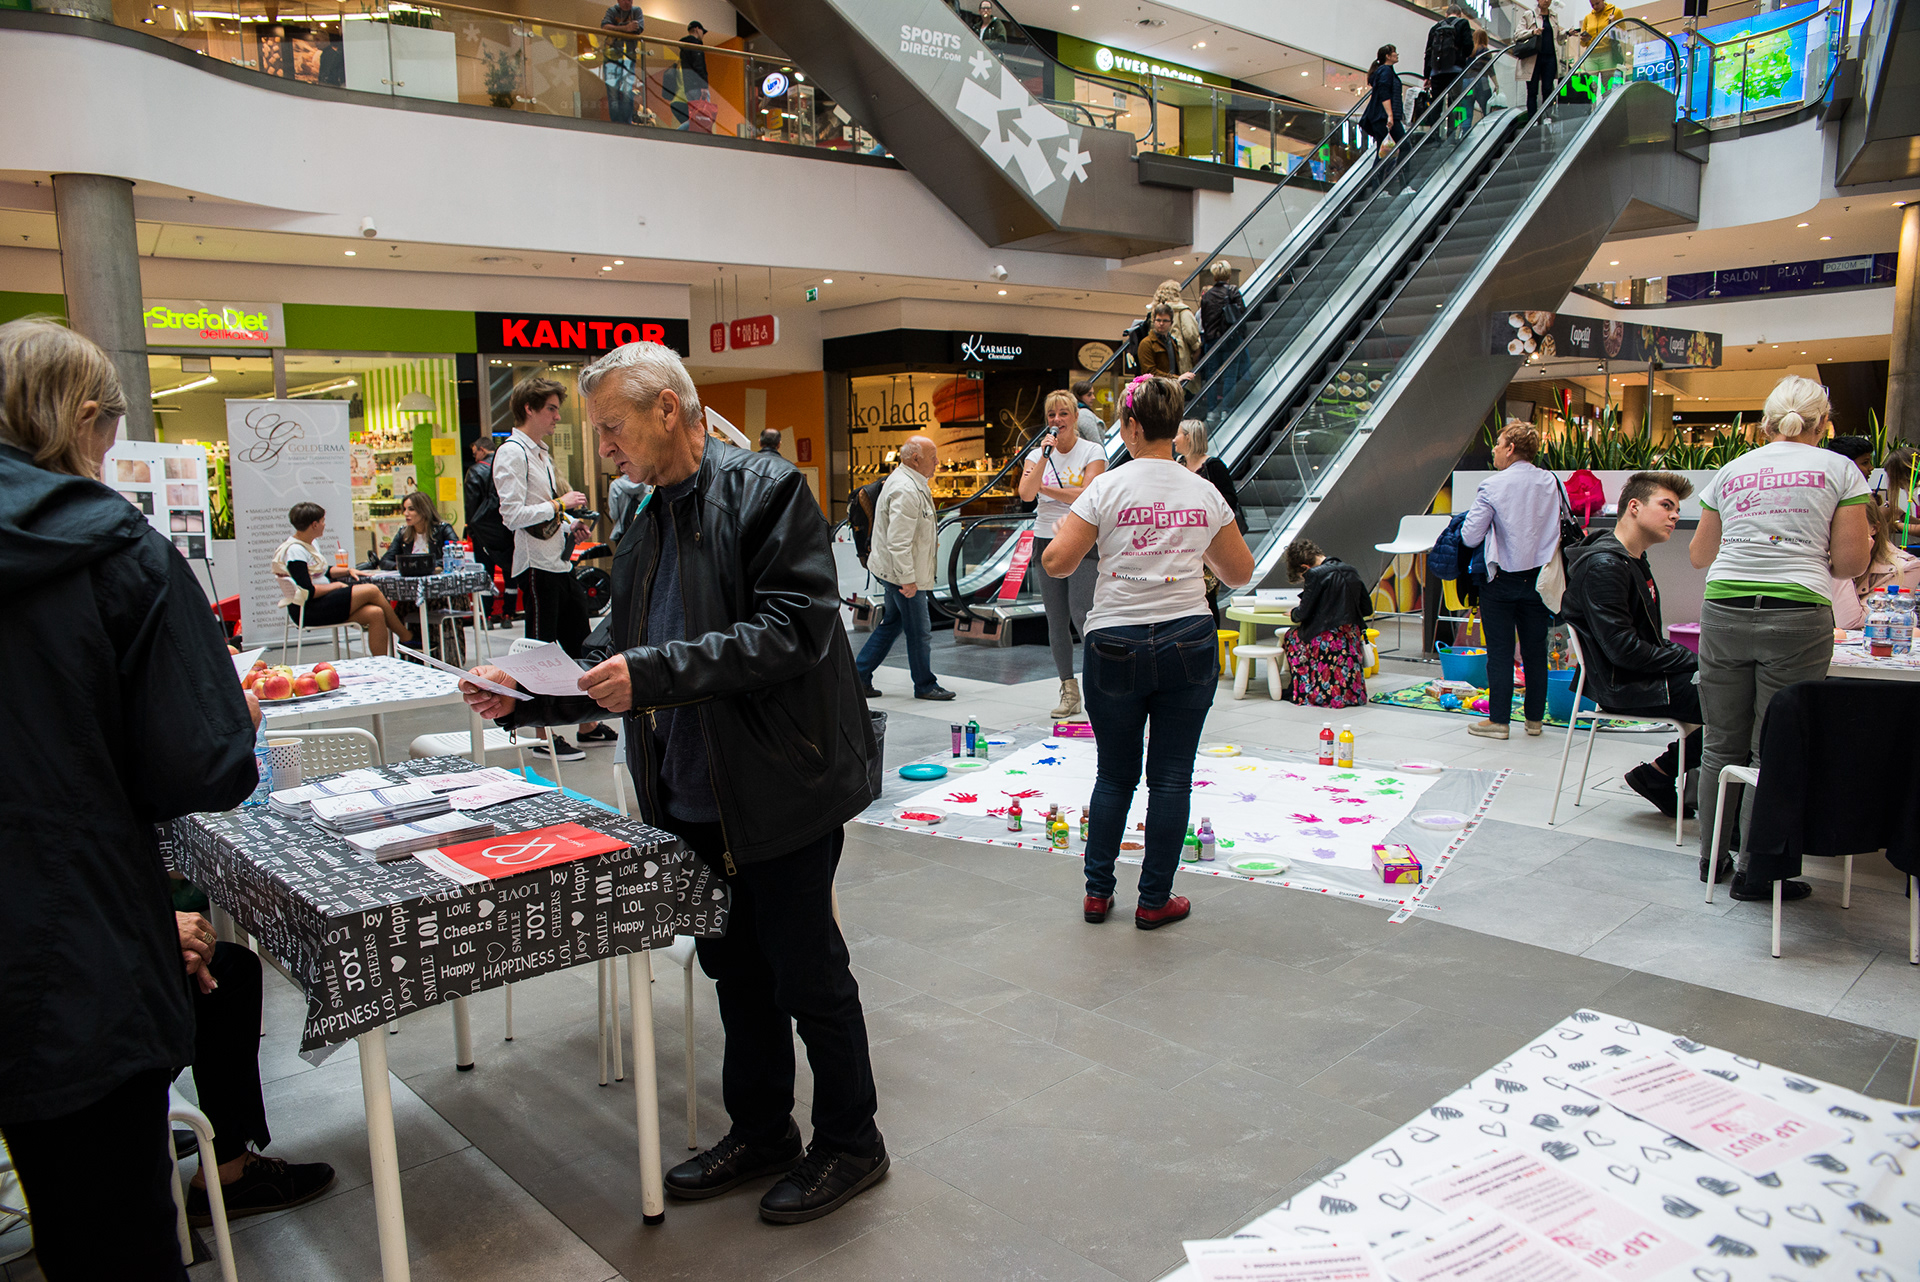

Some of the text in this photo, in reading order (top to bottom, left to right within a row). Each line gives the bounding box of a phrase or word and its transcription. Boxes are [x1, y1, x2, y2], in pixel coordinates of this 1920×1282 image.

[900, 24, 961, 50] SPORTS
[899, 40, 961, 63] DIRECT.COM
[1115, 55, 1148, 74] YVES
[1637, 56, 1689, 77] POGOD
[1722, 264, 1807, 284] SALON PLAY
[1826, 261, 1857, 272] POZIOM
[502, 318, 665, 349] KANTOR
[980, 345, 1022, 355] KARMELLO
[852, 387, 931, 427] kolada
[288, 443, 345, 453] GOLDERMA
[1763, 472, 1823, 489] BIUST
[1158, 511, 1206, 527] BIUST
[660, 850, 696, 866] LOVE
[550, 869, 568, 886] Joy
[619, 863, 638, 877] LOVE
[498, 883, 540, 903] LOVE
[615, 880, 659, 898] Cheers
[662, 872, 674, 893] FUN
[691, 864, 711, 906] CHEERS
[447, 902, 471, 917] LOVE
[551, 890, 562, 938] CHEERS
[622, 900, 645, 914] LOL
[362, 912, 383, 929] Joy
[443, 920, 492, 940] Cheers
[497, 909, 507, 932] FUN
[526, 902, 546, 940] JOY
[613, 920, 645, 935] Happy
[694, 910, 708, 936] LOL
[709, 904, 728, 934] Joy
[511, 911, 522, 953] SMILE
[596, 911, 609, 955] SMILE
[452, 941, 477, 957] LOL
[559, 939, 572, 967] LOL
[574, 929, 591, 961] Joy
[339, 947, 365, 992] JOY
[364, 933, 382, 988] CHEERS
[441, 961, 475, 979] Happy
[483, 949, 555, 981] HAPPINESS
[323, 959, 344, 1009] SMILE
[420, 954, 438, 1002] SMILE
[381, 988, 397, 1020] LOL
[399, 976, 418, 1011] Joy
[304, 1000, 380, 1040] HAPPINESS
[1721, 1130, 1771, 1159] BIUST
